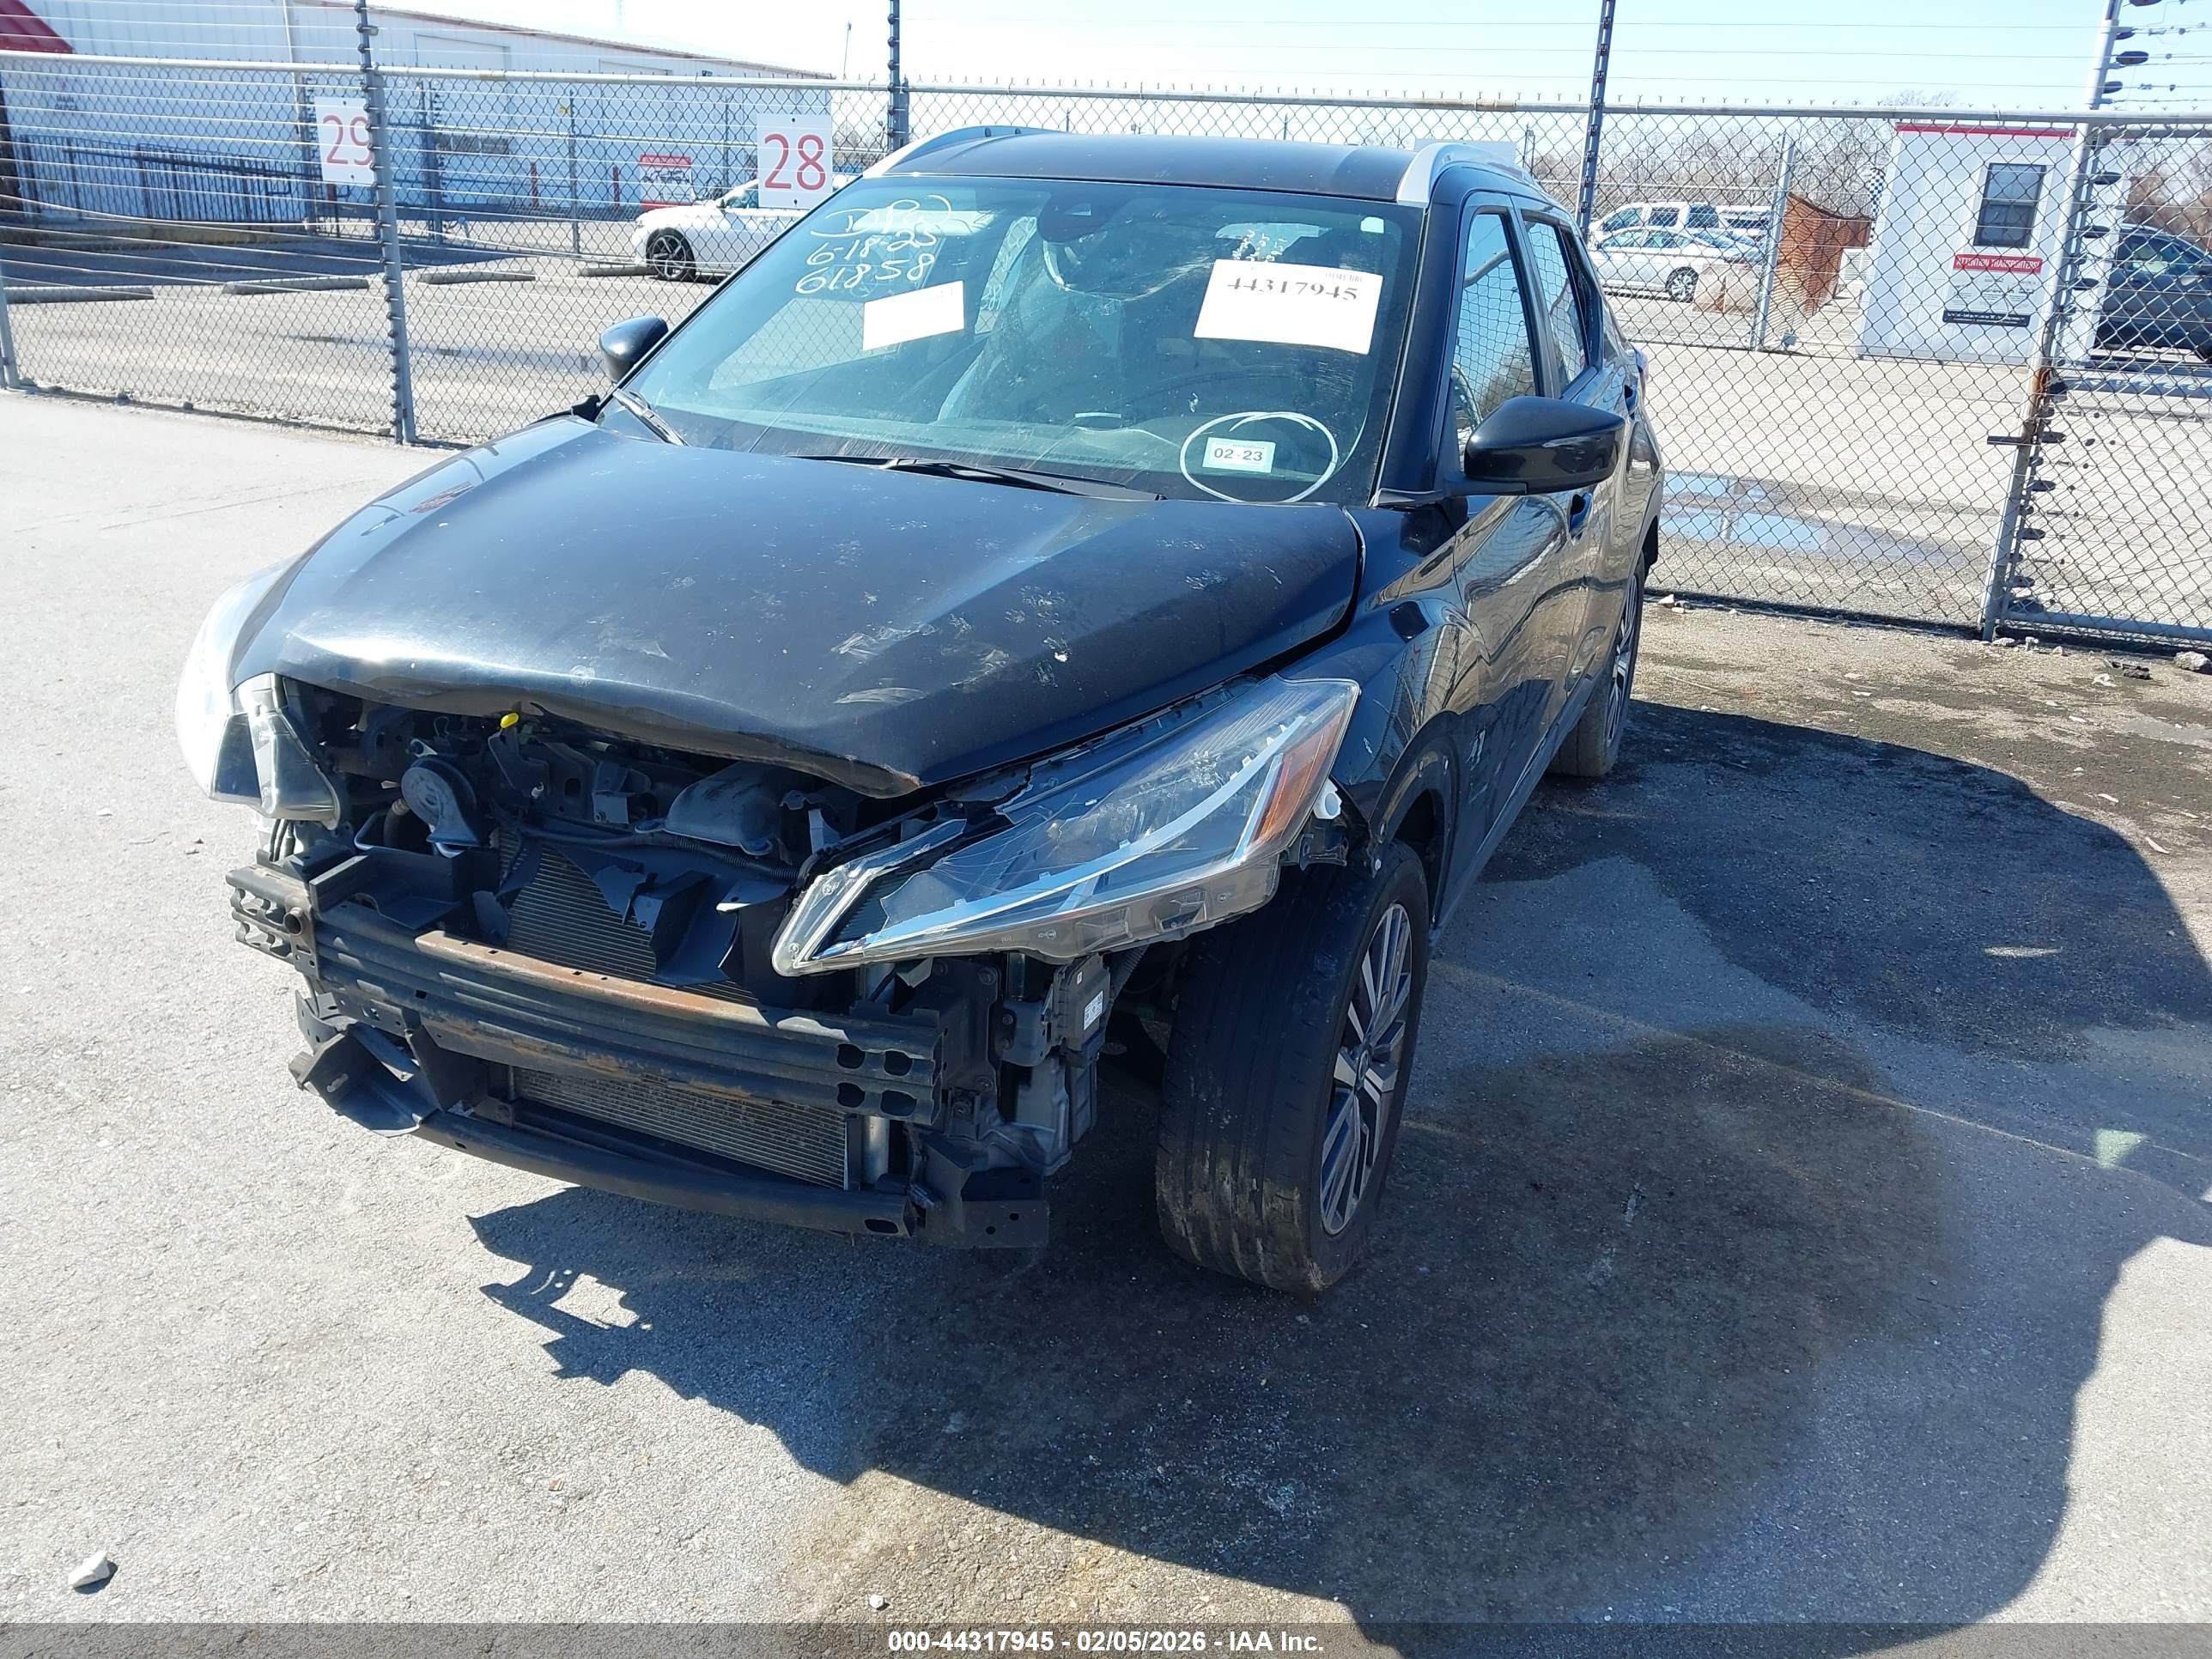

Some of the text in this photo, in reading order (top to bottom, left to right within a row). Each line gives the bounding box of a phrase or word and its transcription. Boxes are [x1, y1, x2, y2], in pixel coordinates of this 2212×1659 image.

[323, 115, 373, 166] 29
[764, 133, 826, 191] 28
[795, 252, 935, 295] 61858
[1227, 276, 1358, 301] 44317945
